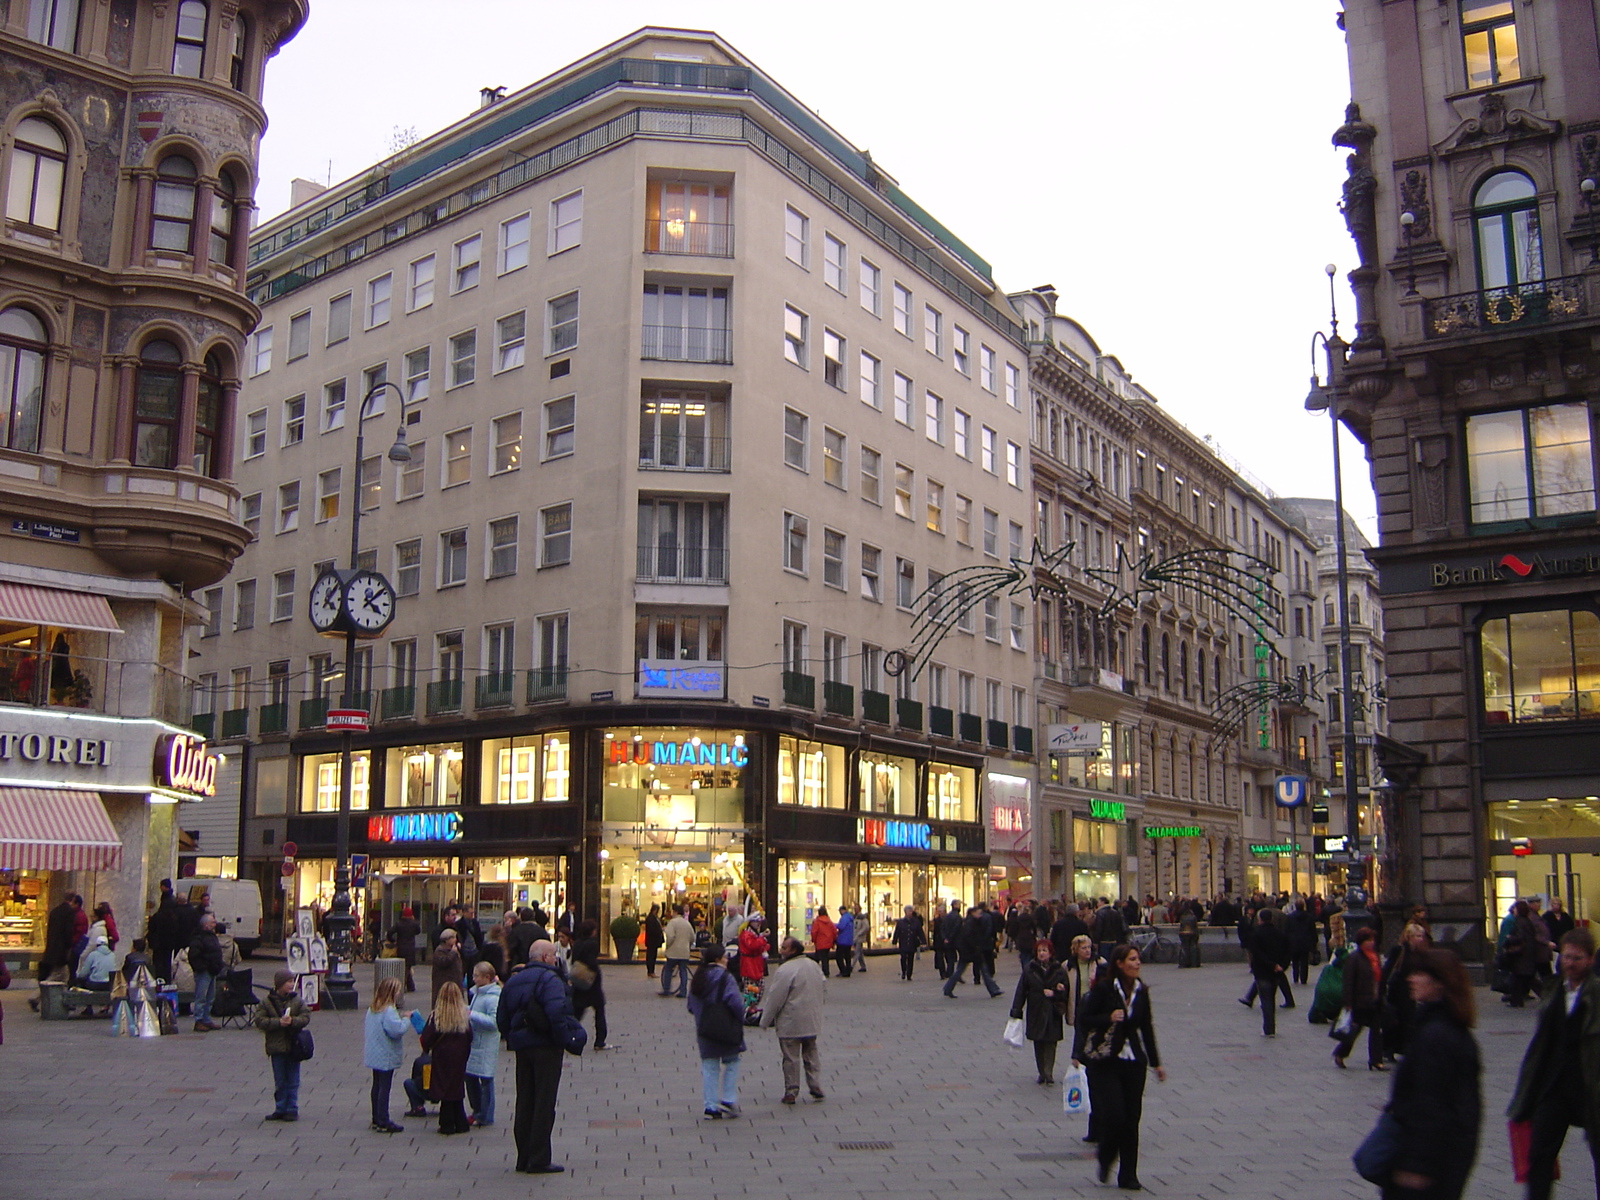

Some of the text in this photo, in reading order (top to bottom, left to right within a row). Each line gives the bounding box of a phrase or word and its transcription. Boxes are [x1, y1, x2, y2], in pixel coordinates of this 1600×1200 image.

[18, 521, 24, 529] 2
[1431, 559, 1504, 586] Bank
[670, 667, 721, 690] Reader's
[692, 681, 720, 692] Digest
[332, 716, 352, 724] POLIZEI
[0, 732, 114, 766] TOREI
[608, 739, 750, 768] HUMANIC
[169, 733, 217, 796] Aida
[1278, 780, 1300, 803] U
[367, 811, 459, 842] HUMANIC
[864, 817, 931, 851] HUMANIC
[1145, 826, 1201, 838] SALAMANDER
[1250, 843, 1300, 853] SALAMANDR
